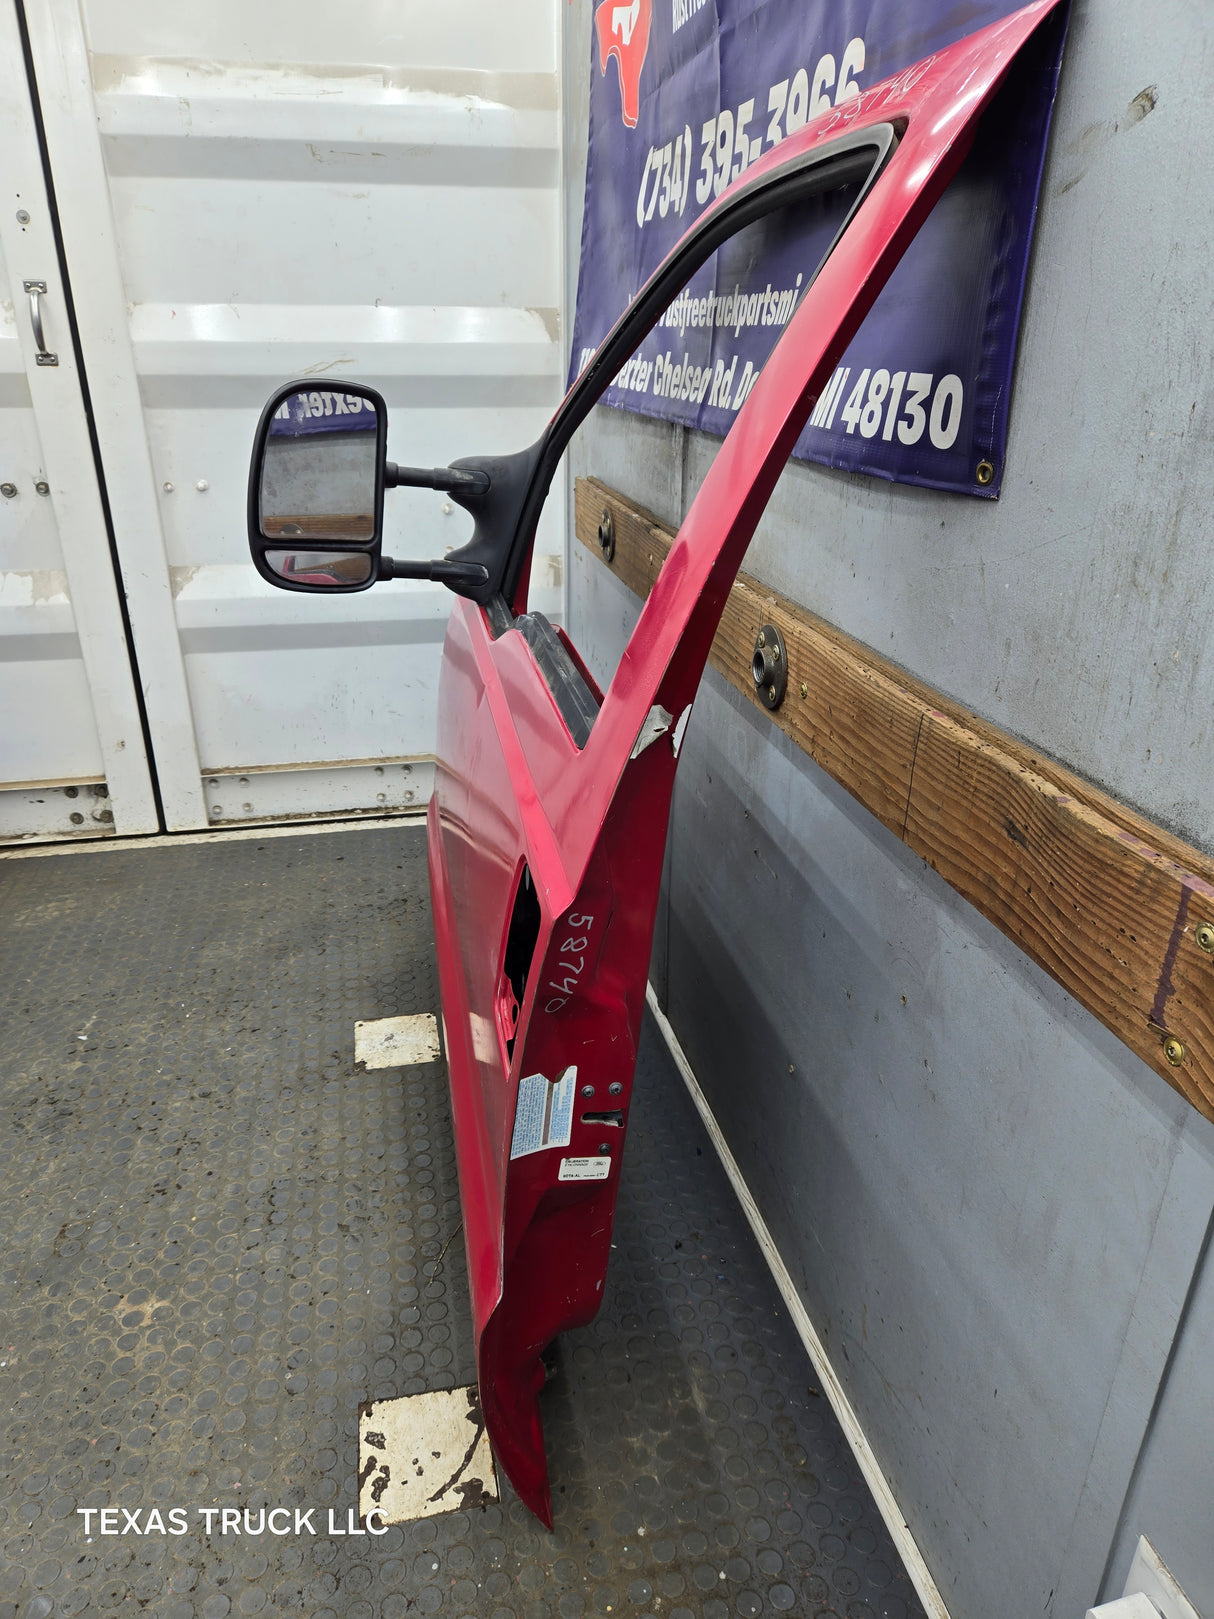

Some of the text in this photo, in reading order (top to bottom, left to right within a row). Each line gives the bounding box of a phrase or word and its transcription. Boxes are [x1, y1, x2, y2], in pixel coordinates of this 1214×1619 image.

[637, 37, 866, 228] (734) 395-3966
[610, 353, 654, 393] exter
[653, 351, 713, 404] Chelsea
[708, 355, 739, 410] Rd.
[841, 368, 964, 450] 48130
